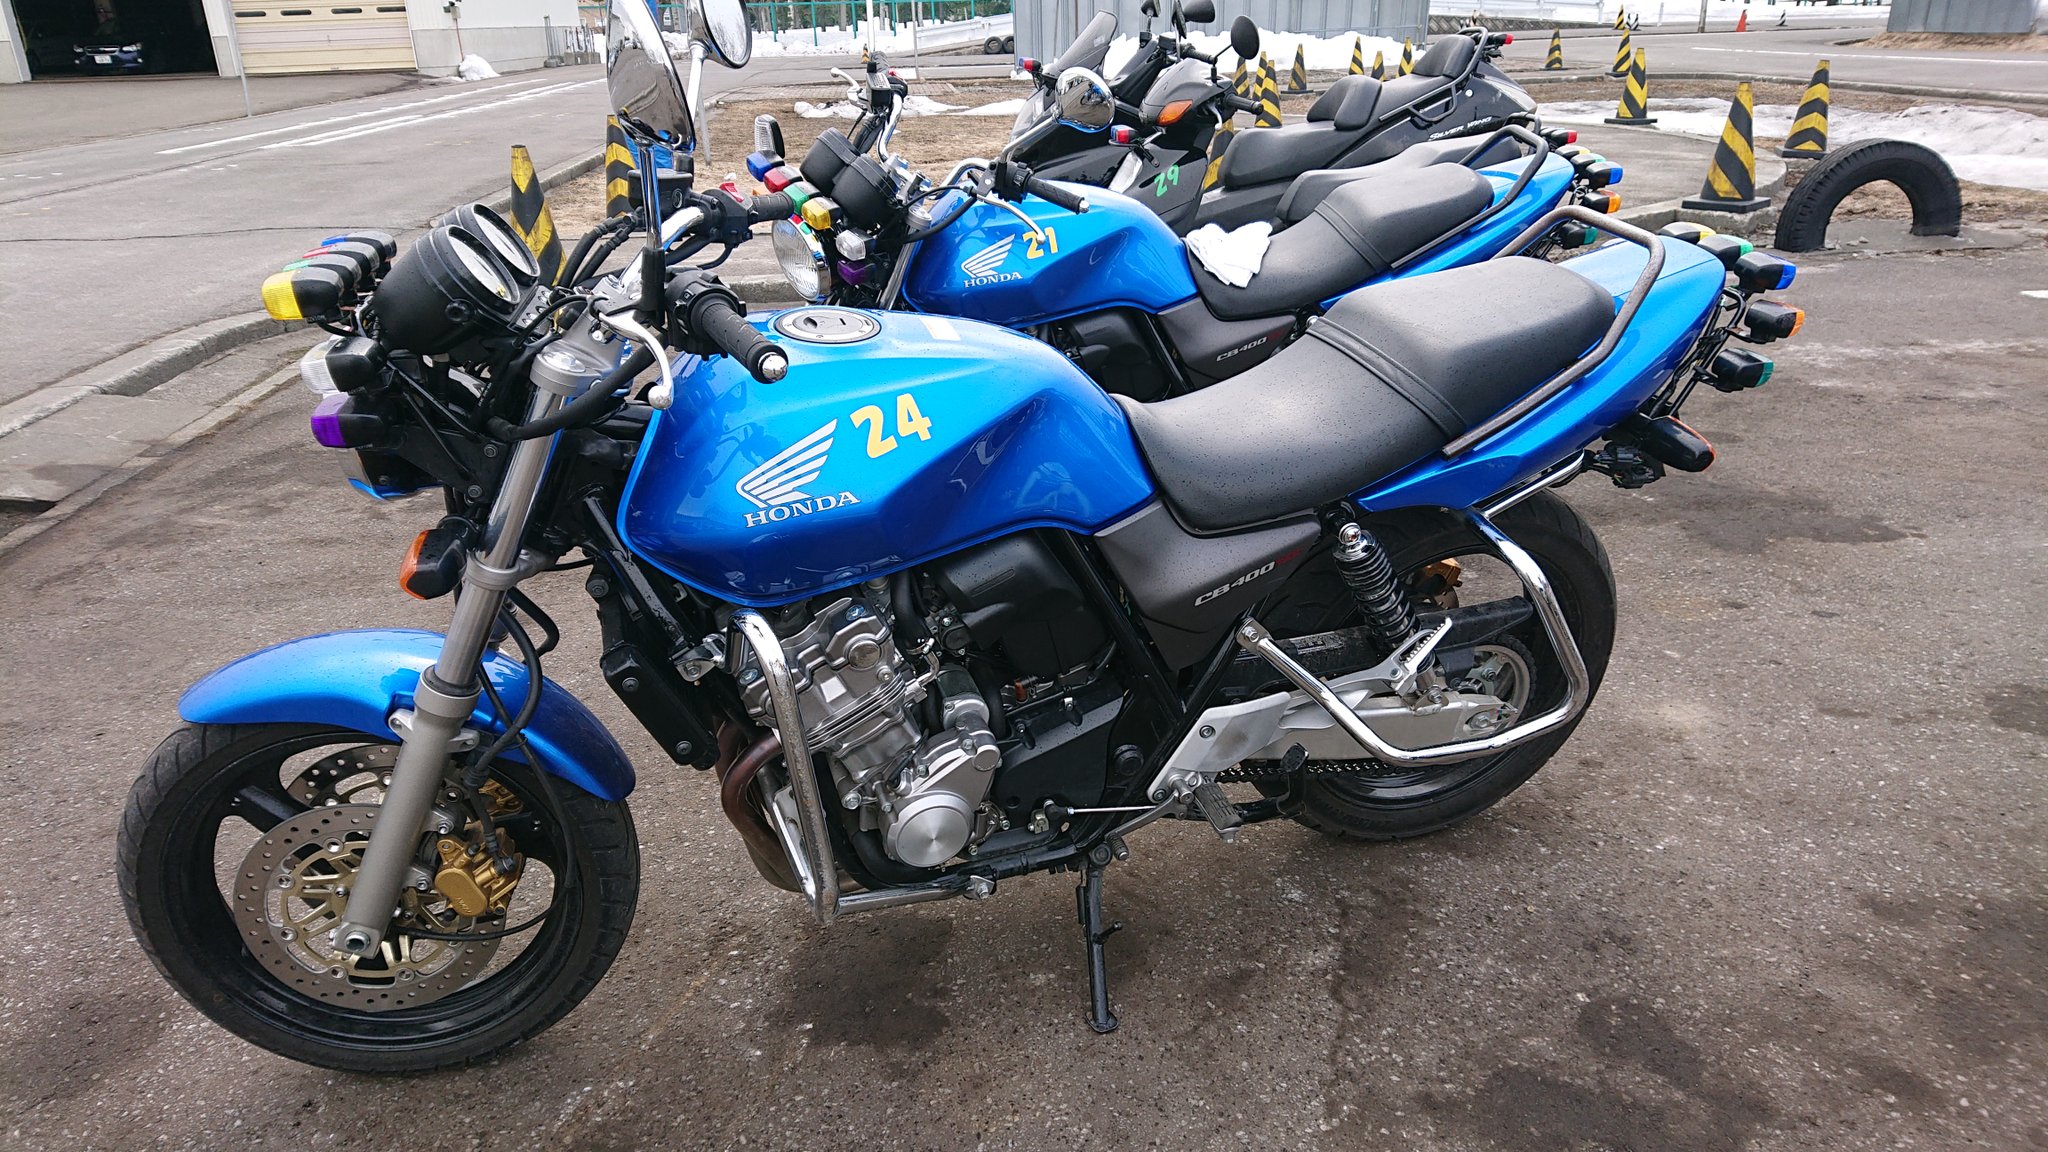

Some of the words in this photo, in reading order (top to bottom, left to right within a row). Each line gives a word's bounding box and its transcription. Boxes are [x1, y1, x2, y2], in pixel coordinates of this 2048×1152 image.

[1154, 165, 1179, 197] 29
[1022, 226, 1059, 259] 21
[963, 271, 1023, 288] HONDA
[1216, 336, 1268, 362] CB400
[849, 393, 932, 459] 24
[743, 491, 860, 528] HONDA
[1194, 561, 1276, 607] CB400
